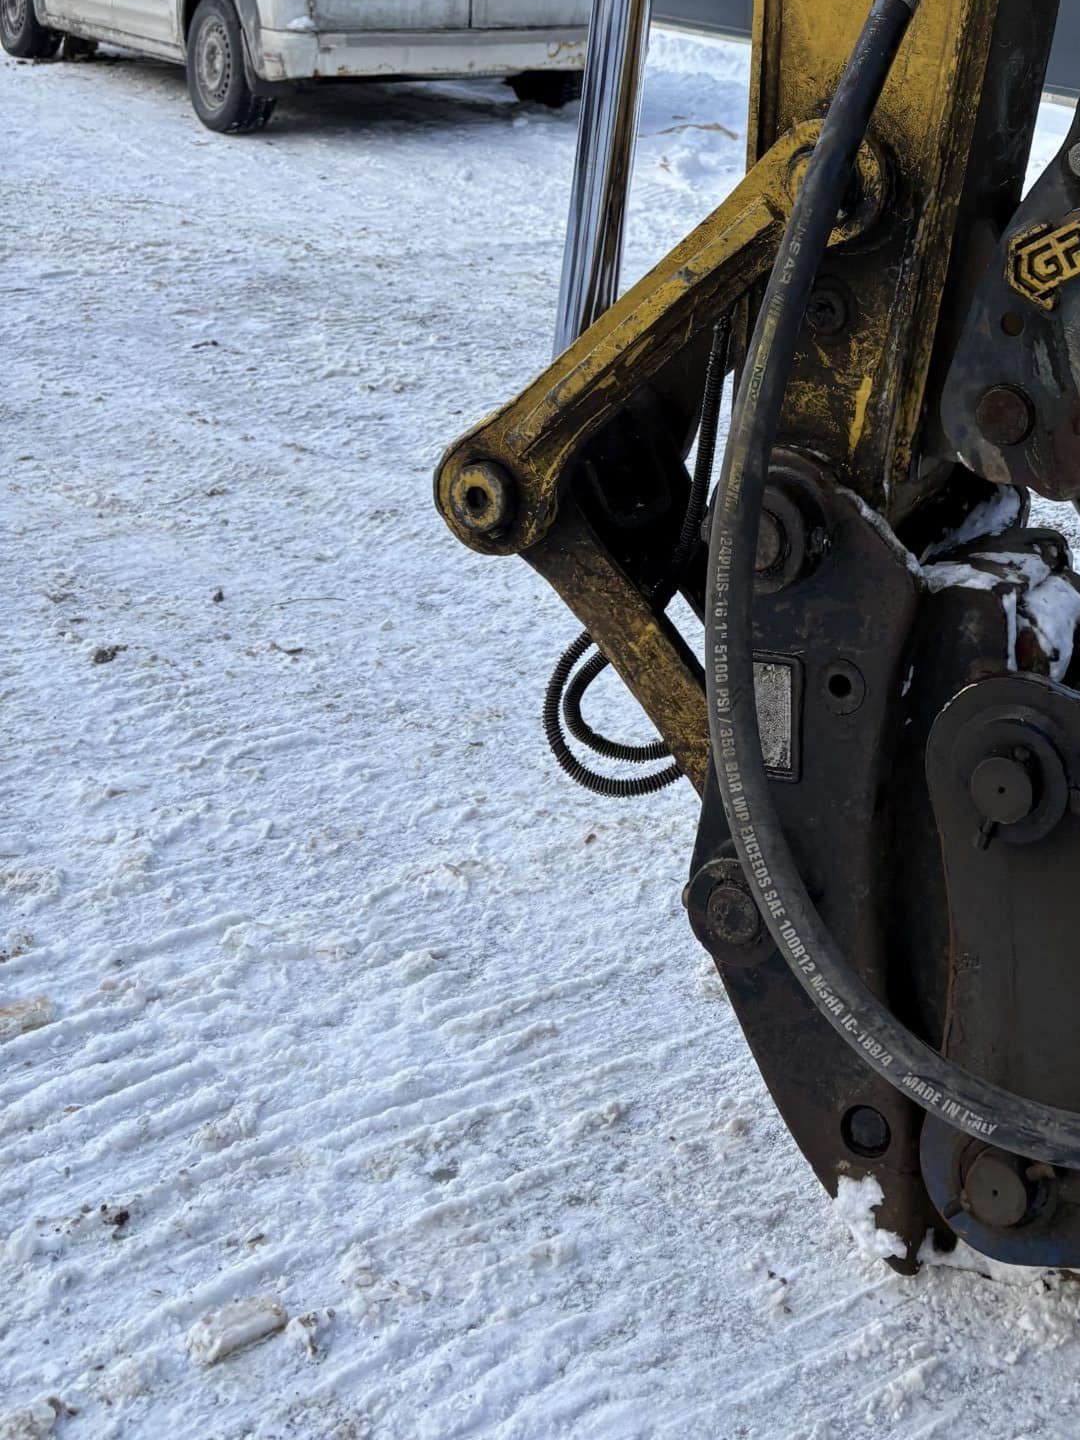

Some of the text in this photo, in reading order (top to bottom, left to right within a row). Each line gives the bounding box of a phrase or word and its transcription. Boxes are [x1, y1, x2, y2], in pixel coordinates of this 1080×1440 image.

[713, 622, 728, 639] 1"
[714, 645, 728, 683] 5100
[715, 688, 730, 713] PSI
[716, 715, 732, 725] /
[718, 728, 736, 756] 350
[724, 762, 743, 793] BAR
[731, 796, 750, 822] WP
[738, 825, 772, 889] EXCEEDS
[763, 889, 786, 919] SAE
[777, 919, 817, 975] 100R12
[809, 975, 845, 1017] MSHA
[839, 1012, 893, 1067] IC-188/4
[901, 1071, 942, 1106] MADE
[940, 1098, 961, 1117] IN
